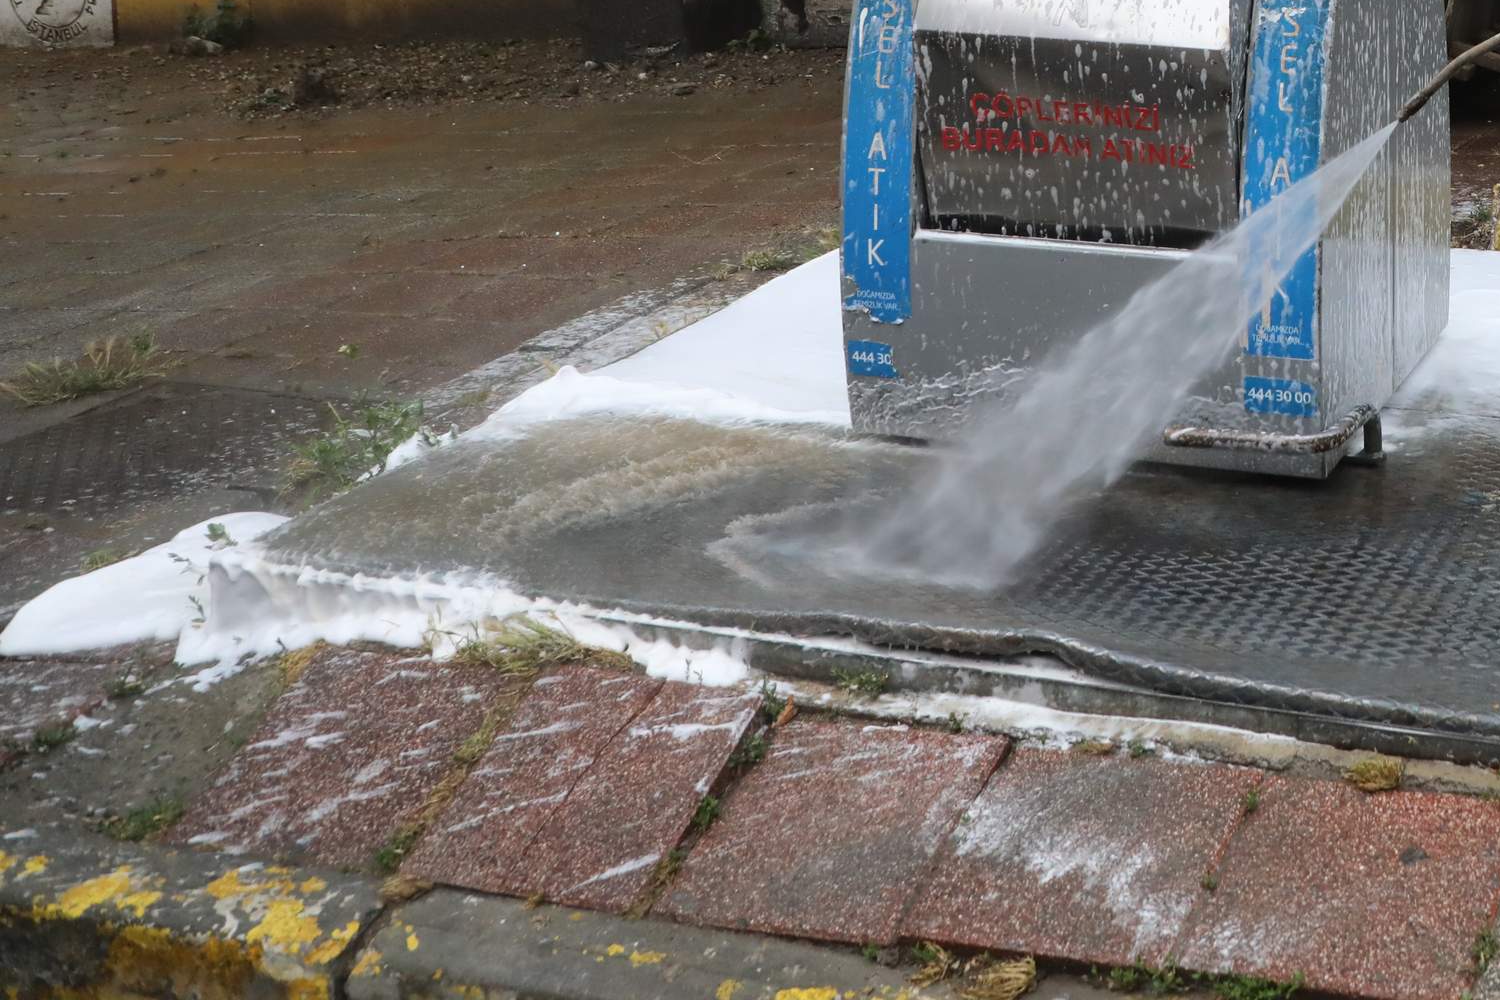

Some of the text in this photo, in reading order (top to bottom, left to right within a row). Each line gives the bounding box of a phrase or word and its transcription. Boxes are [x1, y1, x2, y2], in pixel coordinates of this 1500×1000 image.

[940, 126, 1092, 159] BURADAN
[867, 131, 887, 266] ATIK
[853, 351, 875, 362] 444
[1248, 387, 1311, 404] 444 30 00
